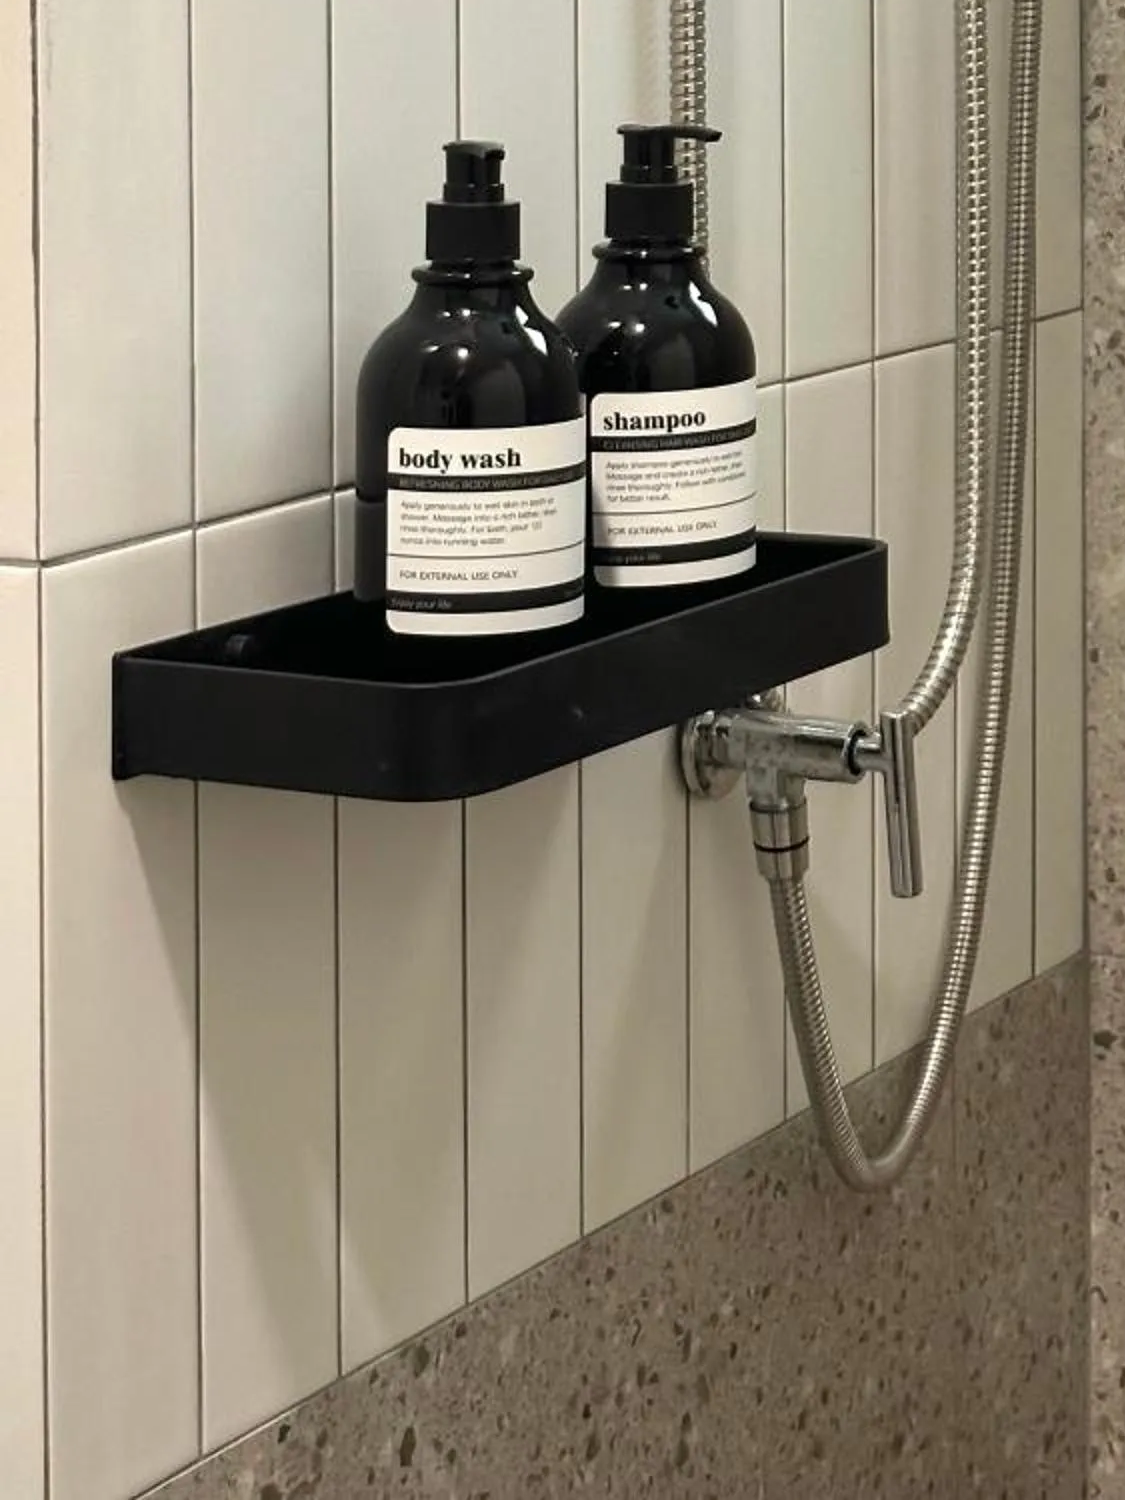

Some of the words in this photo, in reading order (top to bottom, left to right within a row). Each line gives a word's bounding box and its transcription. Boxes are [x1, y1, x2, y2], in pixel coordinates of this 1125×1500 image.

[603, 411, 706, 432] shampoo
[399, 448, 452, 474] body
[461, 449, 521, 469] wash
[607, 526, 626, 536] FOR
[628, 524, 674, 536] EXTERNAL
[696, 520, 717, 531] ONLY
[399, 569, 417, 580] FOR
[419, 570, 468, 581] EXTERNAL
[471, 570, 489, 581] USE
[492, 569, 518, 580] ONLY
